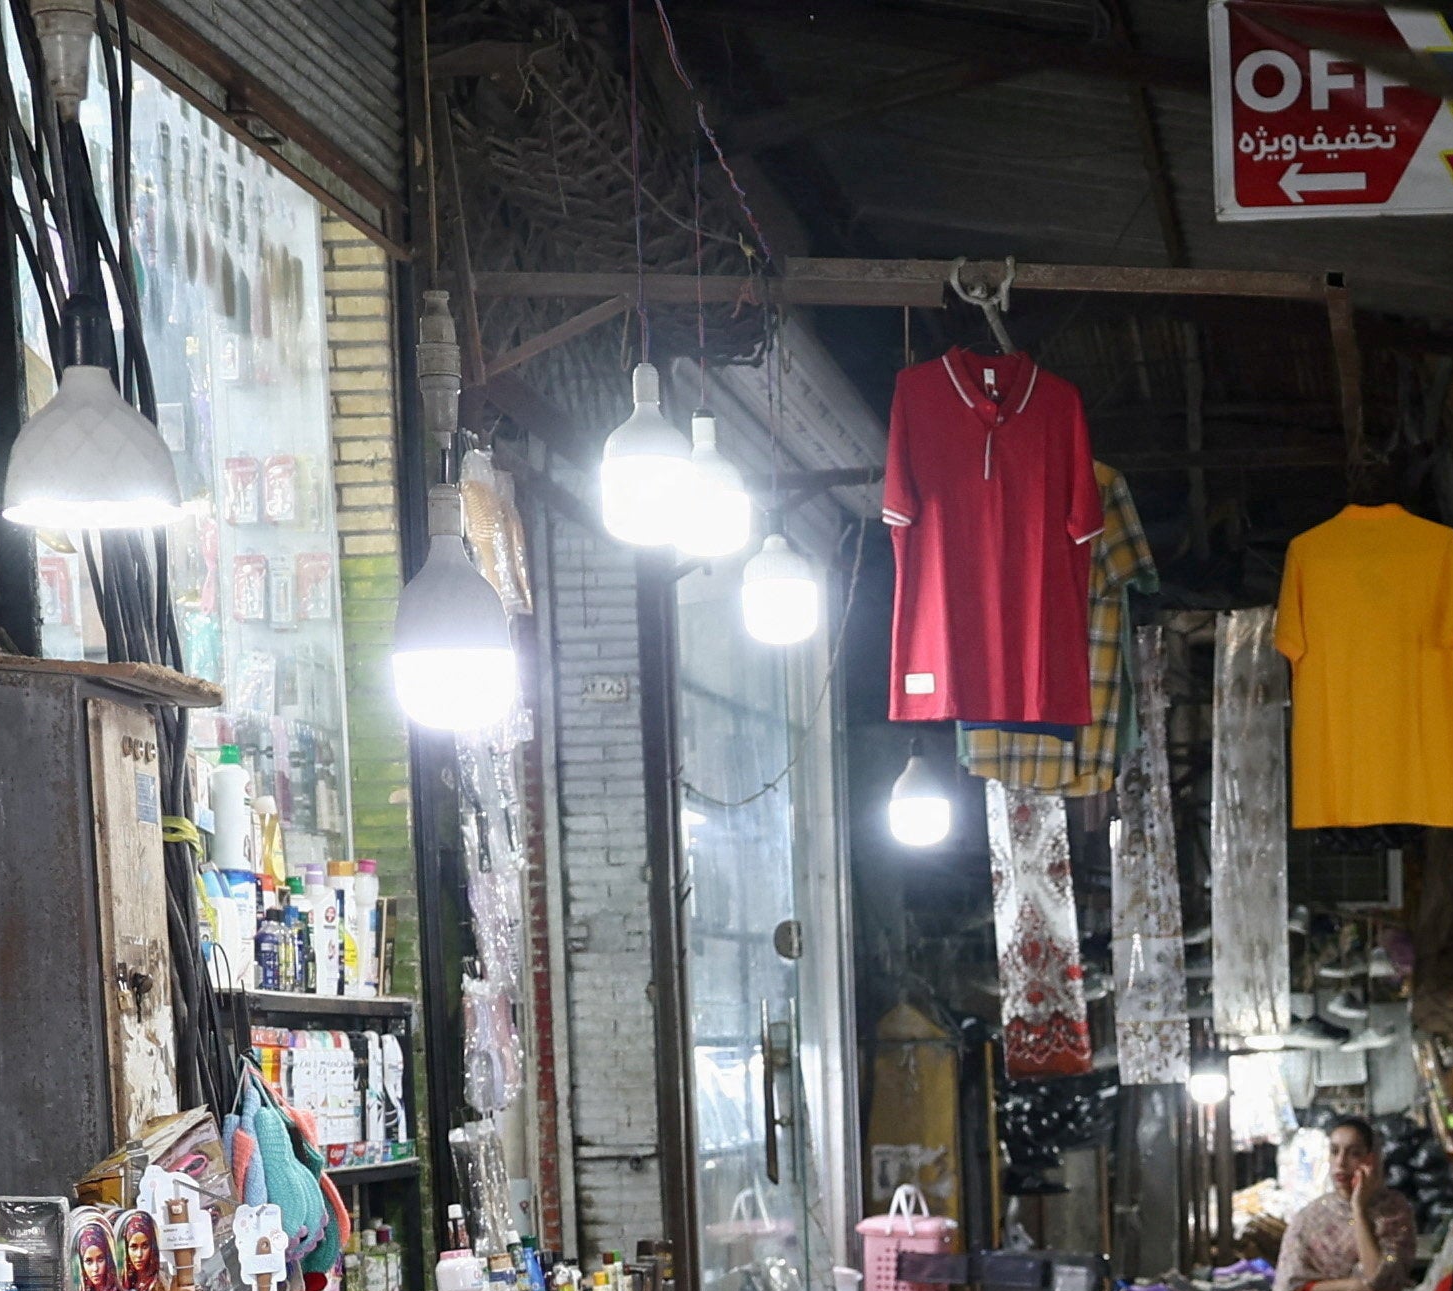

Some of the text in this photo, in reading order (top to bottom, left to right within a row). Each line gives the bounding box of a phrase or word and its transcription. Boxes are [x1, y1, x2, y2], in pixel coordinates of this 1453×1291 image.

[1235, 49, 1410, 112] OFF
[1238, 124, 1397, 161] تخفیف ویژه
